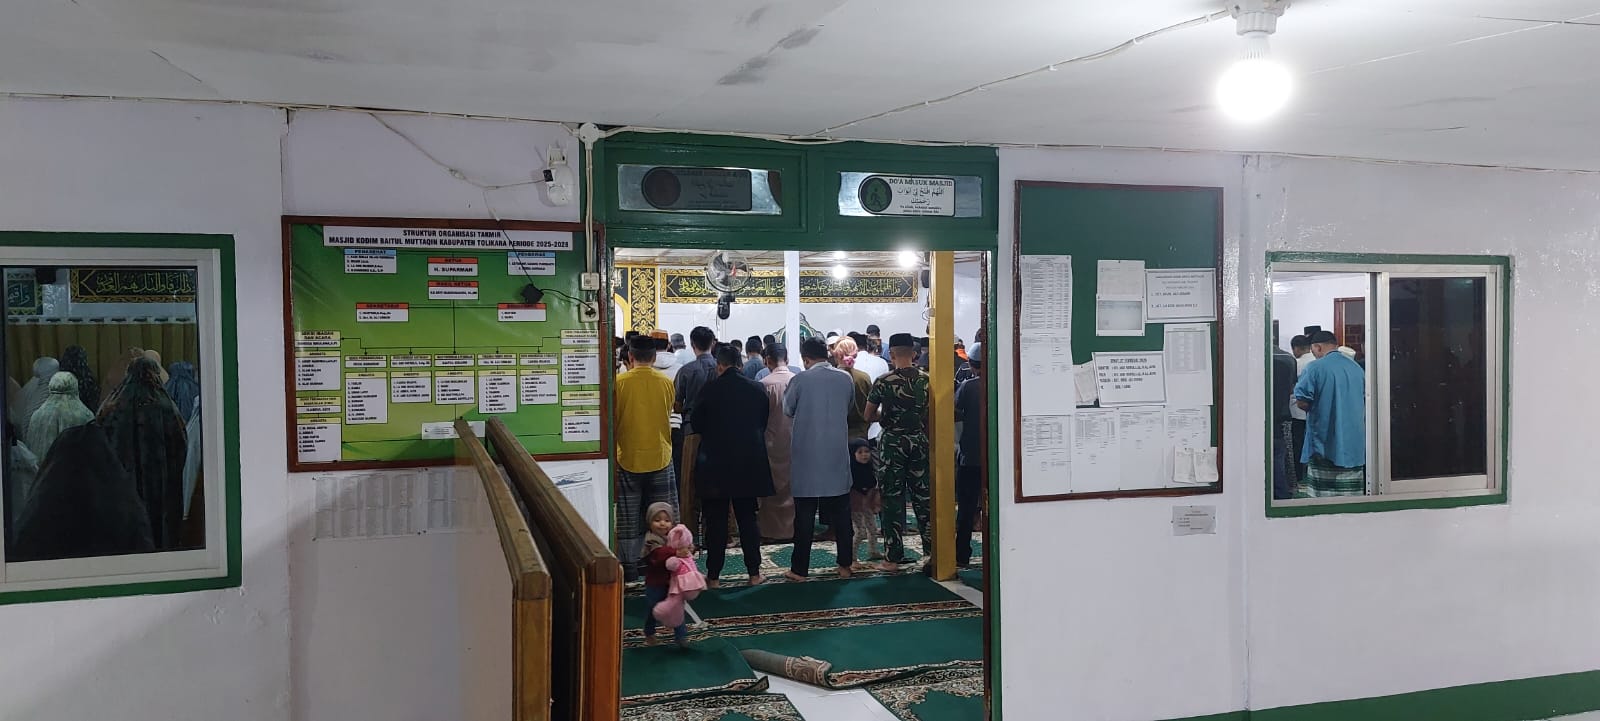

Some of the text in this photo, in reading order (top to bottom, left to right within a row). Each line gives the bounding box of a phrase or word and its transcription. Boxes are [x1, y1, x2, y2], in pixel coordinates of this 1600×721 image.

[904, 178, 928, 186] MASUK
[402, 229, 437, 238] STRUKTUR
[438, 230, 476, 239] ORGANISASI
[328, 236, 355, 244] MASJID
[356, 237, 379, 245] KODIM
[380, 237, 403, 245] BAITUL
[404, 238, 438, 246] MUTTAQIN
[439, 239, 476, 247] KABUPATEN
[477, 240, 507, 248] TOLIKARA
[508, 240, 535, 248] PERIODE
